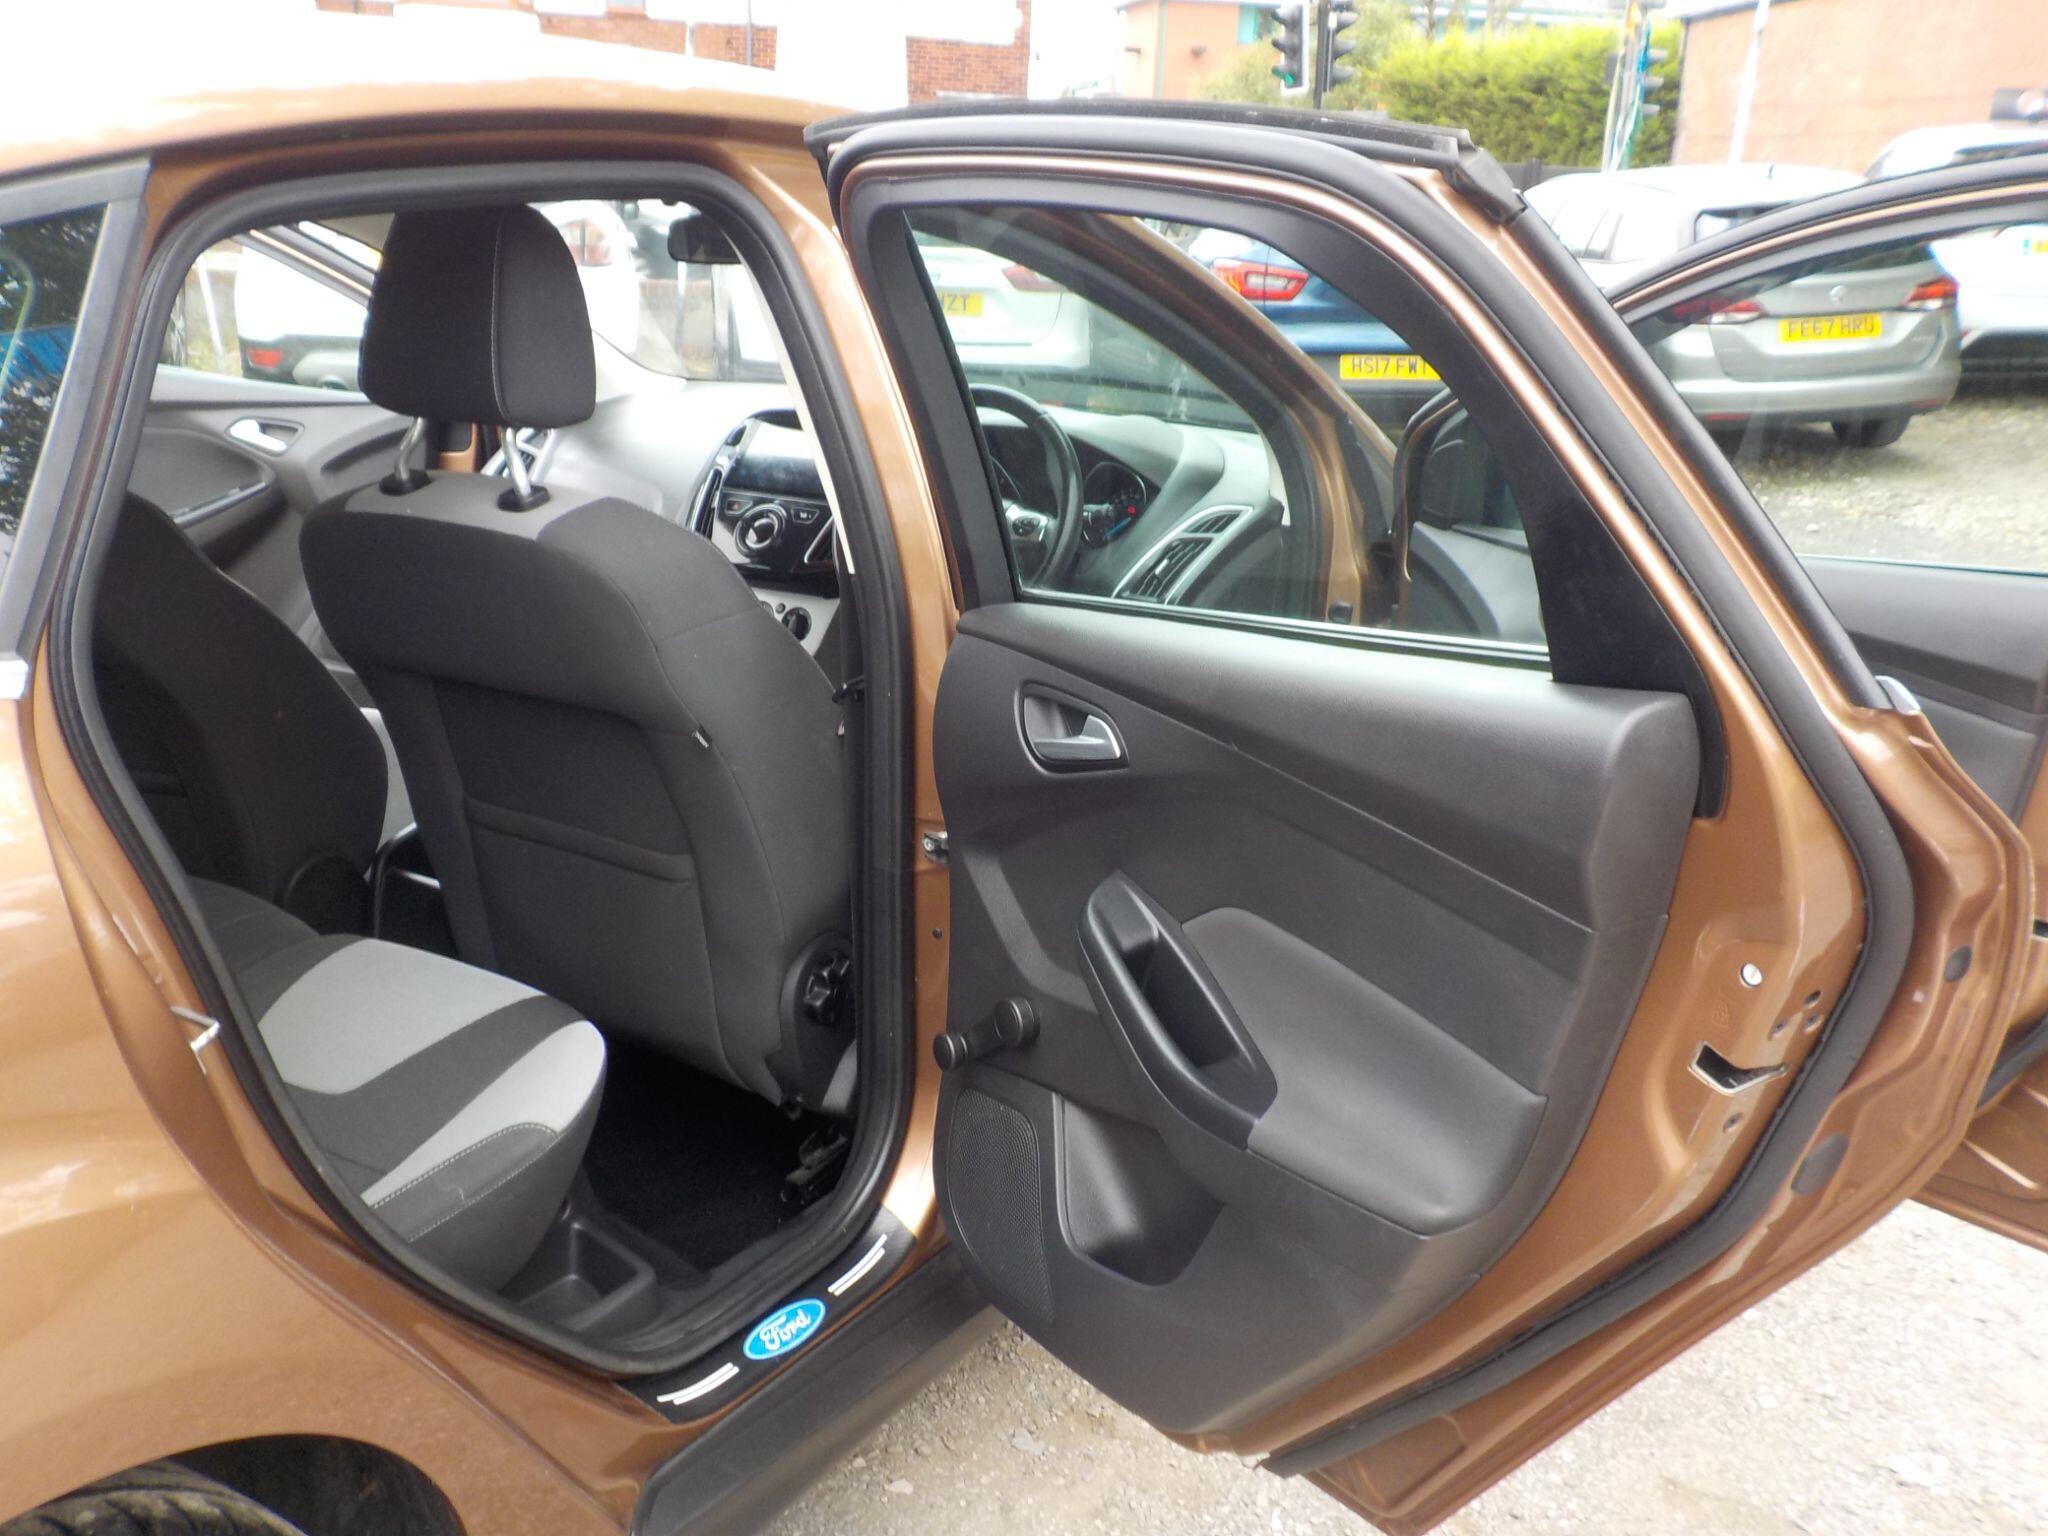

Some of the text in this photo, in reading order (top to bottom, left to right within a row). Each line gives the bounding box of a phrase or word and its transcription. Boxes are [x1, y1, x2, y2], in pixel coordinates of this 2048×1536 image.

[938, 292, 971, 312] ZT
[1787, 318, 1835, 338] FE67
[759, 1309, 811, 1351] Ford
